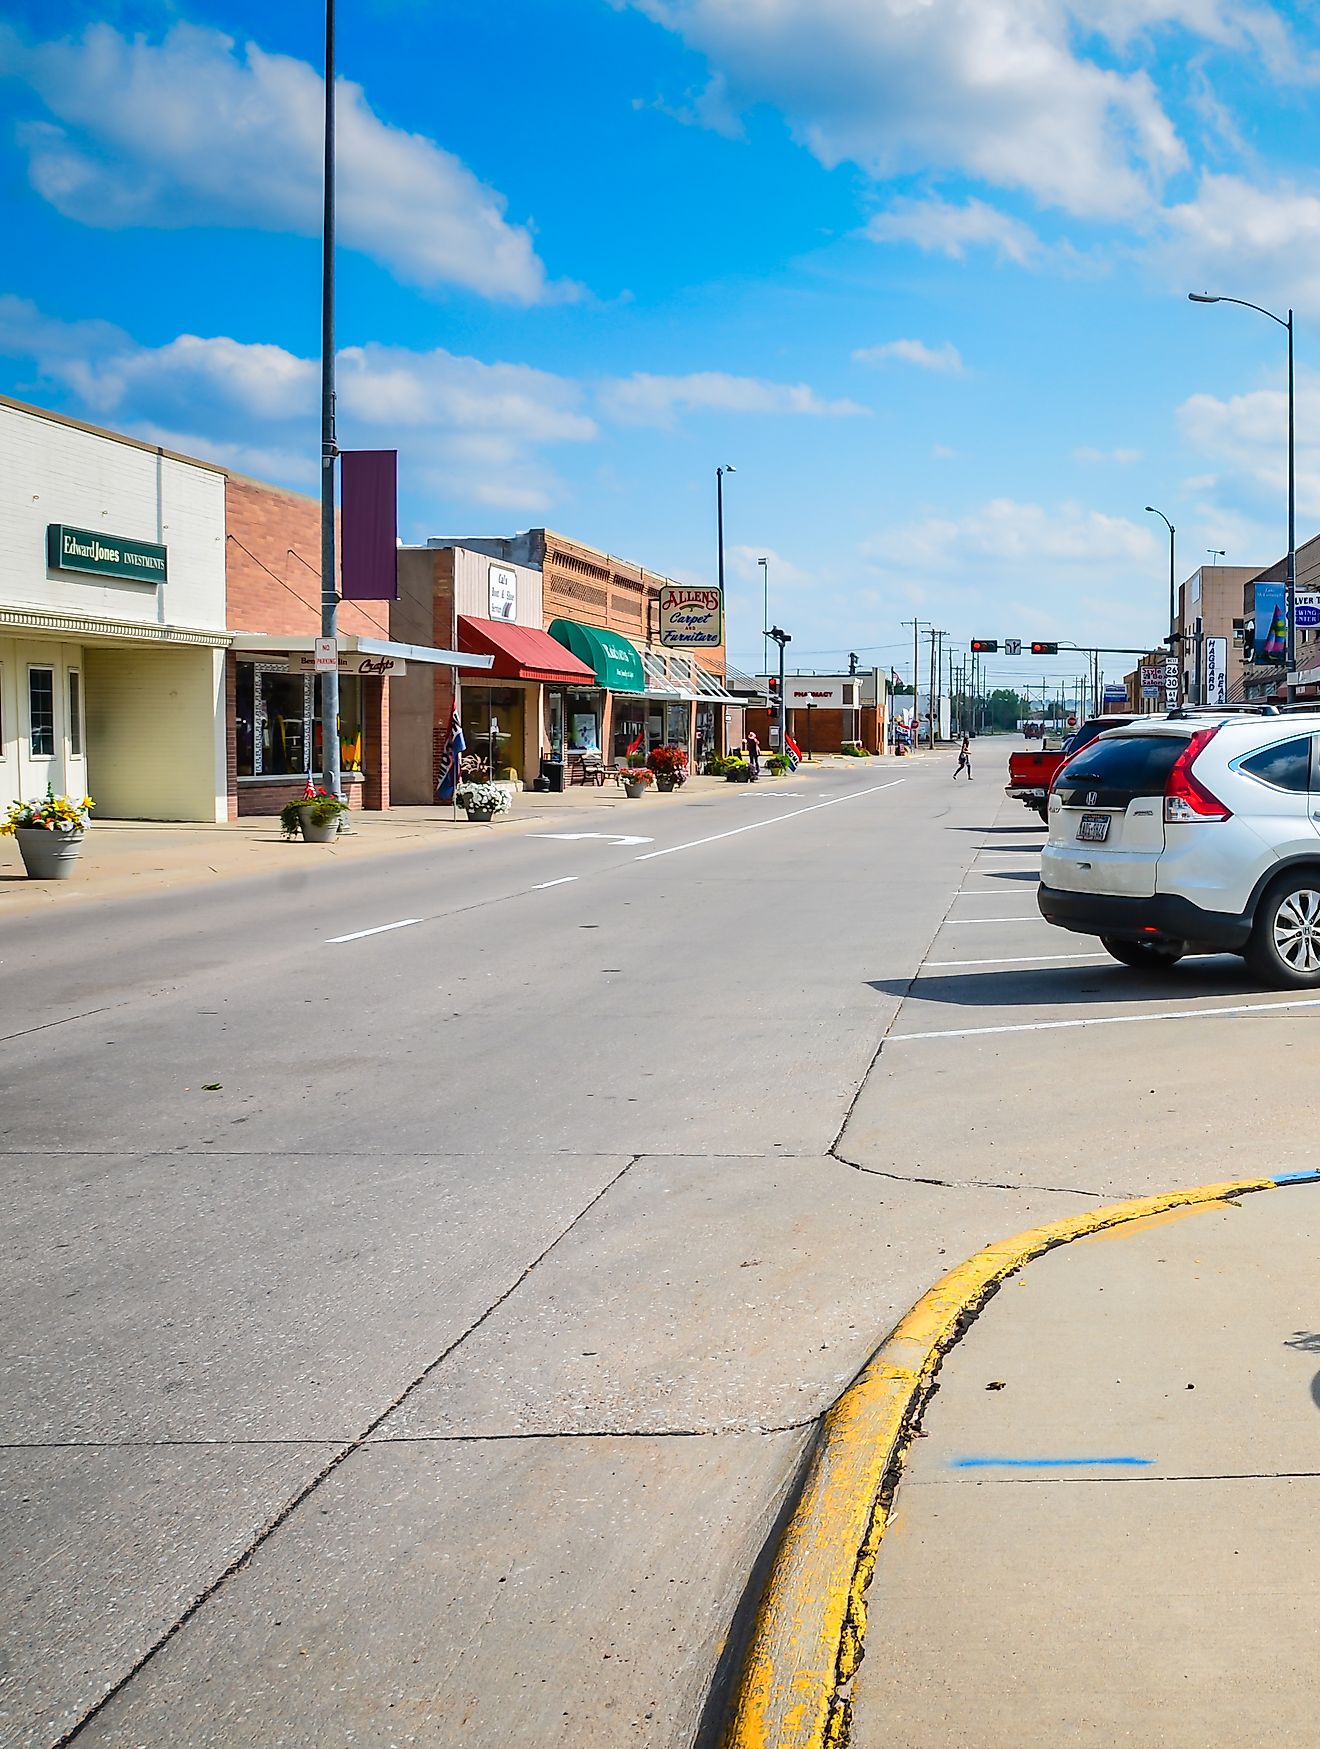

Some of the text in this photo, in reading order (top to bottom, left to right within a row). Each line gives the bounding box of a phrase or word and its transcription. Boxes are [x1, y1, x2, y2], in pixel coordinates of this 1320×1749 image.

[123, 552, 165, 570] INVESTMENTS
[670, 612, 713, 626] Carpet
[664, 630, 718, 642] Furniture
[359, 657, 394, 674] Crafts
[1166, 679, 1177, 687] 30
